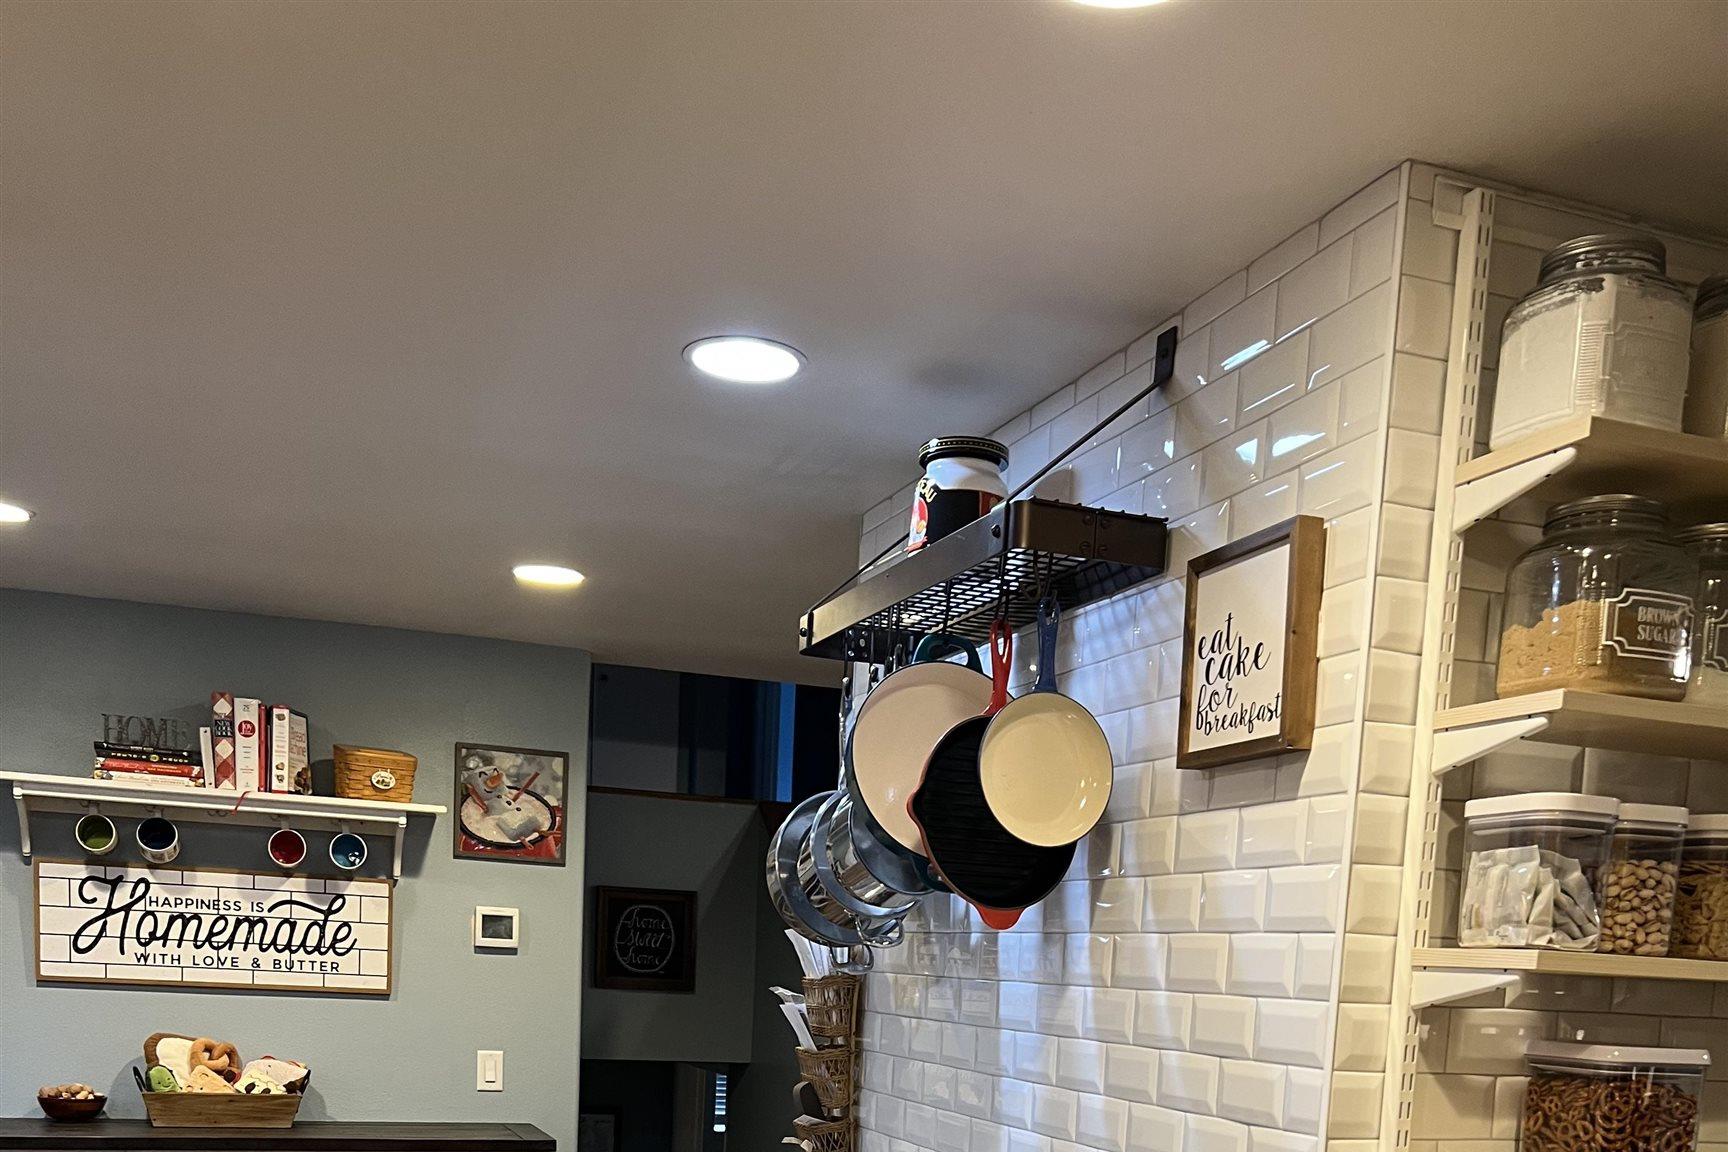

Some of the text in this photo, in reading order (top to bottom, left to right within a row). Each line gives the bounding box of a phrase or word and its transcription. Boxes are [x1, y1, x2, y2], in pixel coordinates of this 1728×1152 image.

[1198, 612, 1239, 660] eat
[1637, 605, 1681, 627] BROWN
[1637, 624, 1681, 645] SUGAR
[1205, 636, 1271, 686] cake
[1195, 682, 1238, 731] for
[1204, 692, 1282, 737] breakfast
[101, 713, 188, 749] HOME
[72, 874, 358, 957] Homemade
[148, 896, 265, 913] HAPPINESS IS
[134, 952, 341, 973] WITH LOVE & BUTTER
